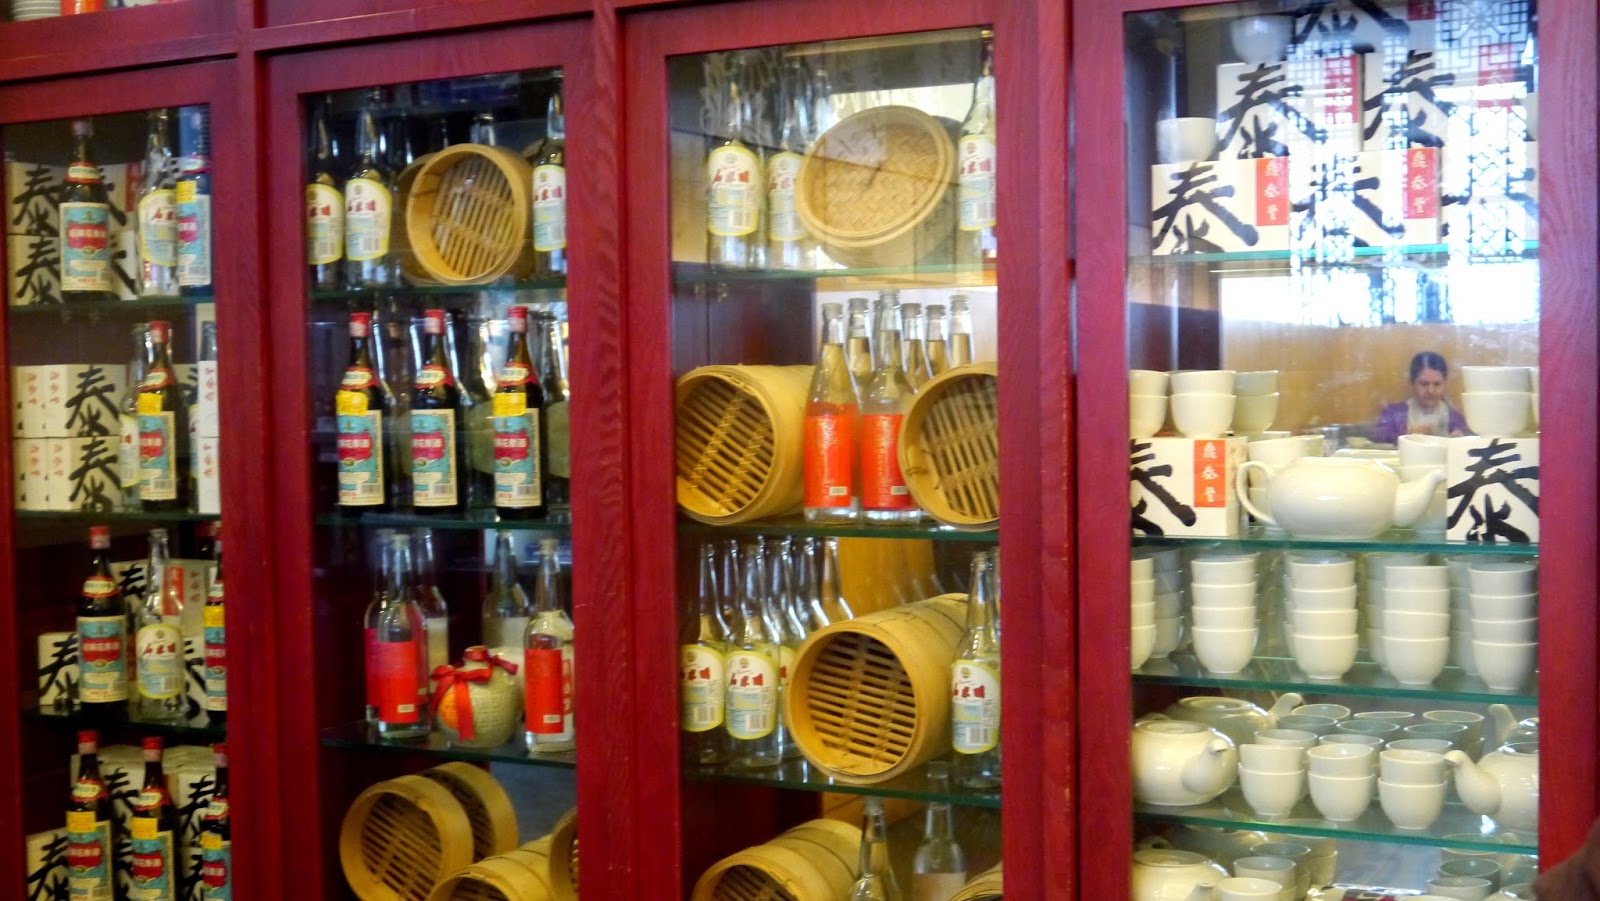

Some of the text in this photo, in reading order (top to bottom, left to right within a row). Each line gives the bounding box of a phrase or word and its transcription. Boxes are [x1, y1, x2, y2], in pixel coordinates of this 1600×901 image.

[1217, 62, 1327, 158] 泰
[1152, 162, 1258, 254] 泰
[65, 366, 119, 436] 泰
[69, 436, 121, 511] 泰
[1447, 438, 1540, 543] 泰
